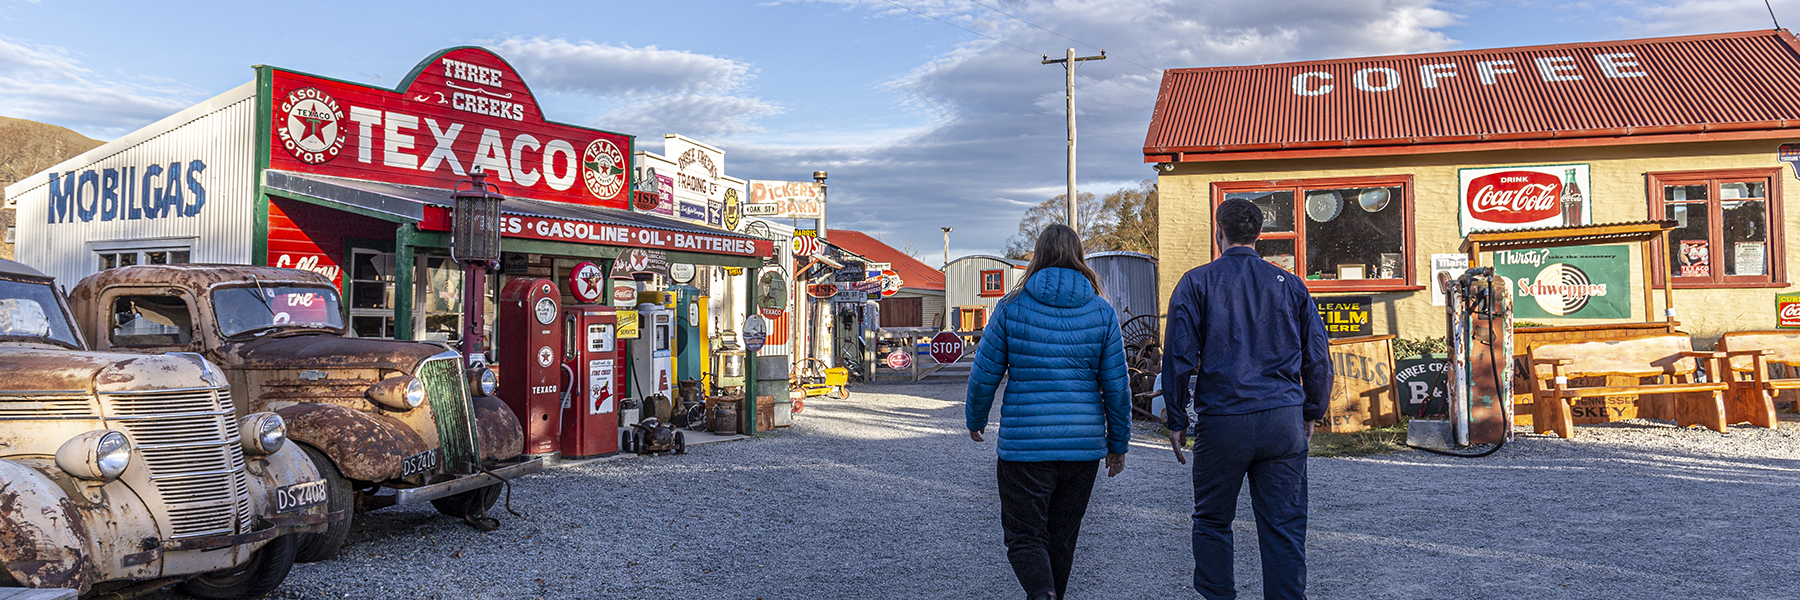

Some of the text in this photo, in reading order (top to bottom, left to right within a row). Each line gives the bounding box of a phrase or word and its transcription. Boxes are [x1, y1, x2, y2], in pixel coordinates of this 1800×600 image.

[442, 58, 502, 87] THREE
[1292, 52, 1648, 97] COFFEE
[281, 89, 344, 120] GASOLINE
[297, 109, 330, 120] TEXACO
[452, 92, 524, 121] CREEKS
[278, 127, 325, 162] MOTOR
[329, 136, 345, 155] OIL
[350, 105, 577, 191] TEXACO
[587, 142, 621, 163] TEXACO
[48, 159, 207, 224] MOBILGAS
[586, 171, 622, 197] GASOLINE
[677, 172, 707, 194] TRADING
[776, 200, 817, 215] BARN
[1472, 183, 1558, 213] Coca-Cola
[536, 219, 629, 243] GASOLINE
[638, 229, 665, 246] OIL
[674, 234, 755, 254] BATTERIES
[1496, 248, 1551, 267] Thirsty?
[1518, 278, 1607, 299] Schweppes
[762, 308, 782, 316] TEXACO
[1325, 324, 1360, 332] ERE
[932, 342, 961, 354] STOP
[1396, 364, 1427, 383] THREE
[532, 385, 557, 395] TEXACO
[1408, 381, 1430, 404] B
[1433, 386, 1443, 398] &
[1572, 406, 1627, 418] SKEY
[403, 457, 417, 476] DS
[278, 483, 327, 510] DS 2408
